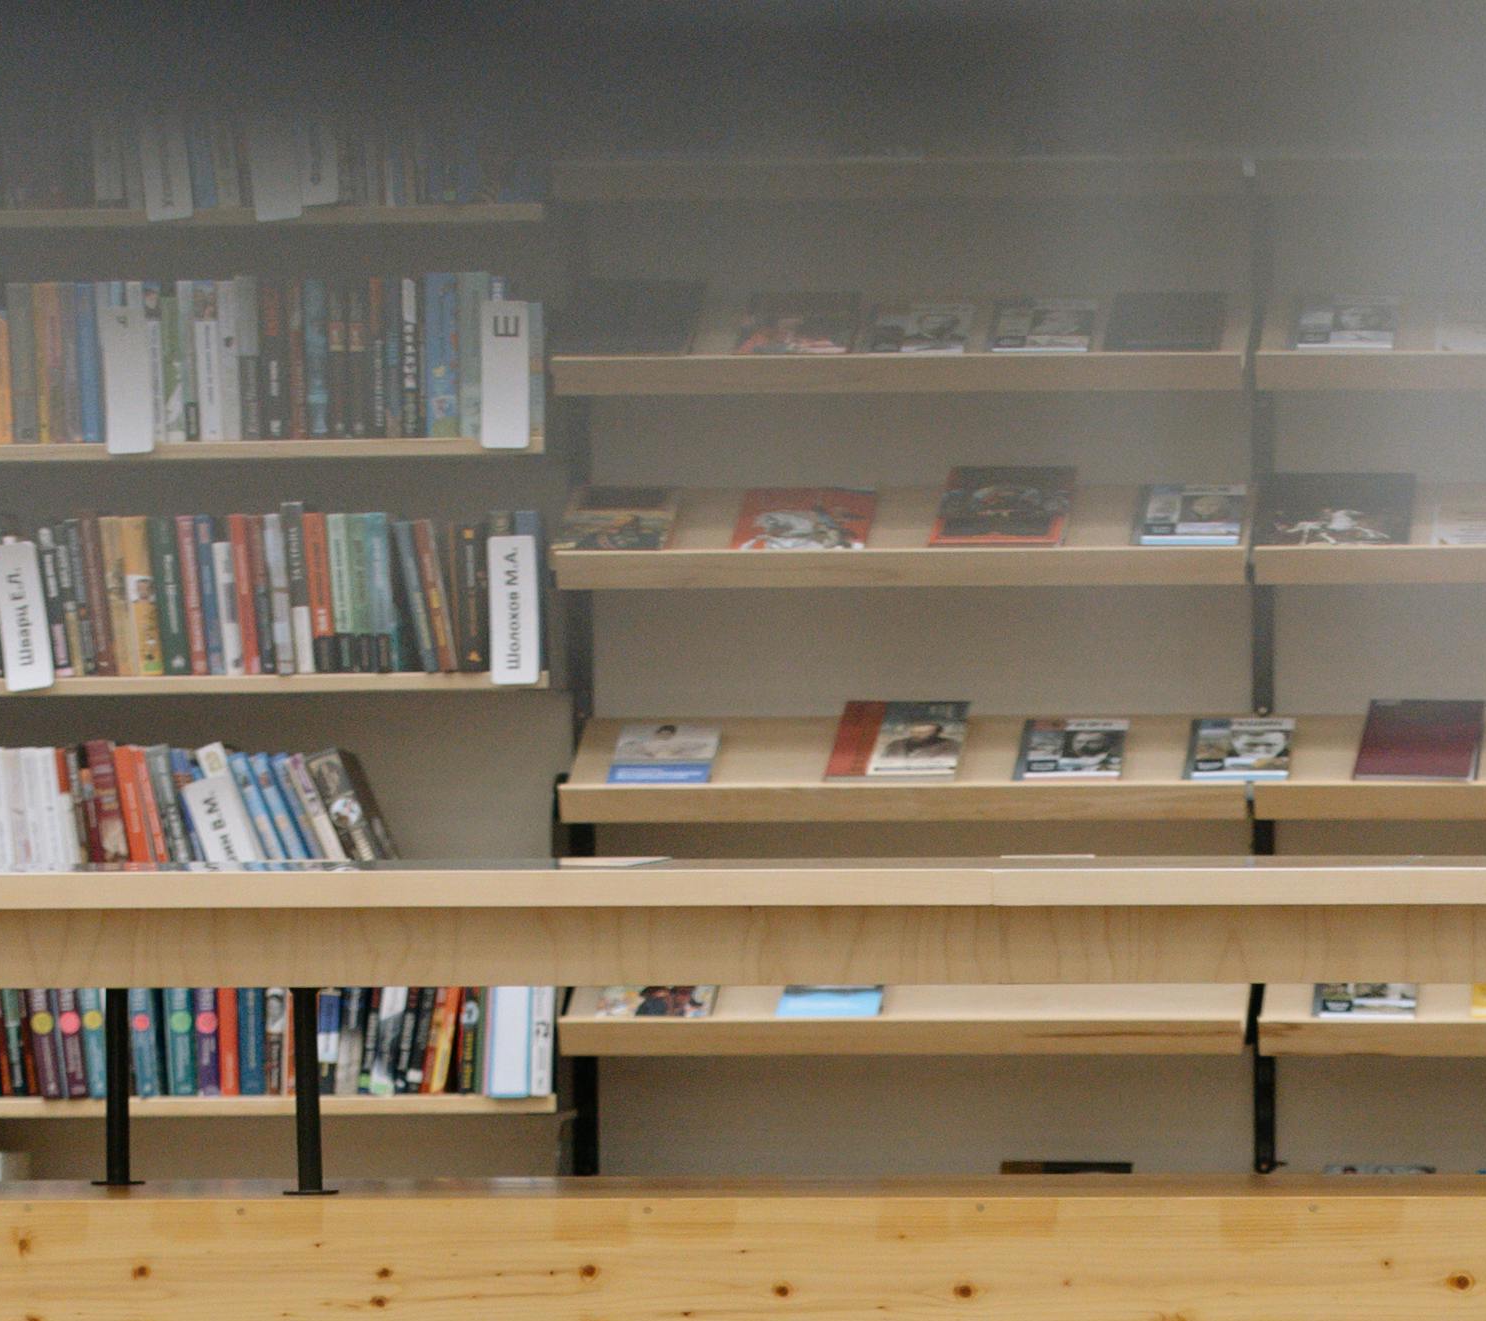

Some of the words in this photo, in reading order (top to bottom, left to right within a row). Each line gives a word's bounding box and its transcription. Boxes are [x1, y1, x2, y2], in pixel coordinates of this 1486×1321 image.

[503, 547, 519, 586] М.А.
[11, 605, 34, 666] Шварц
[505, 591, 520, 670] Шолохов
